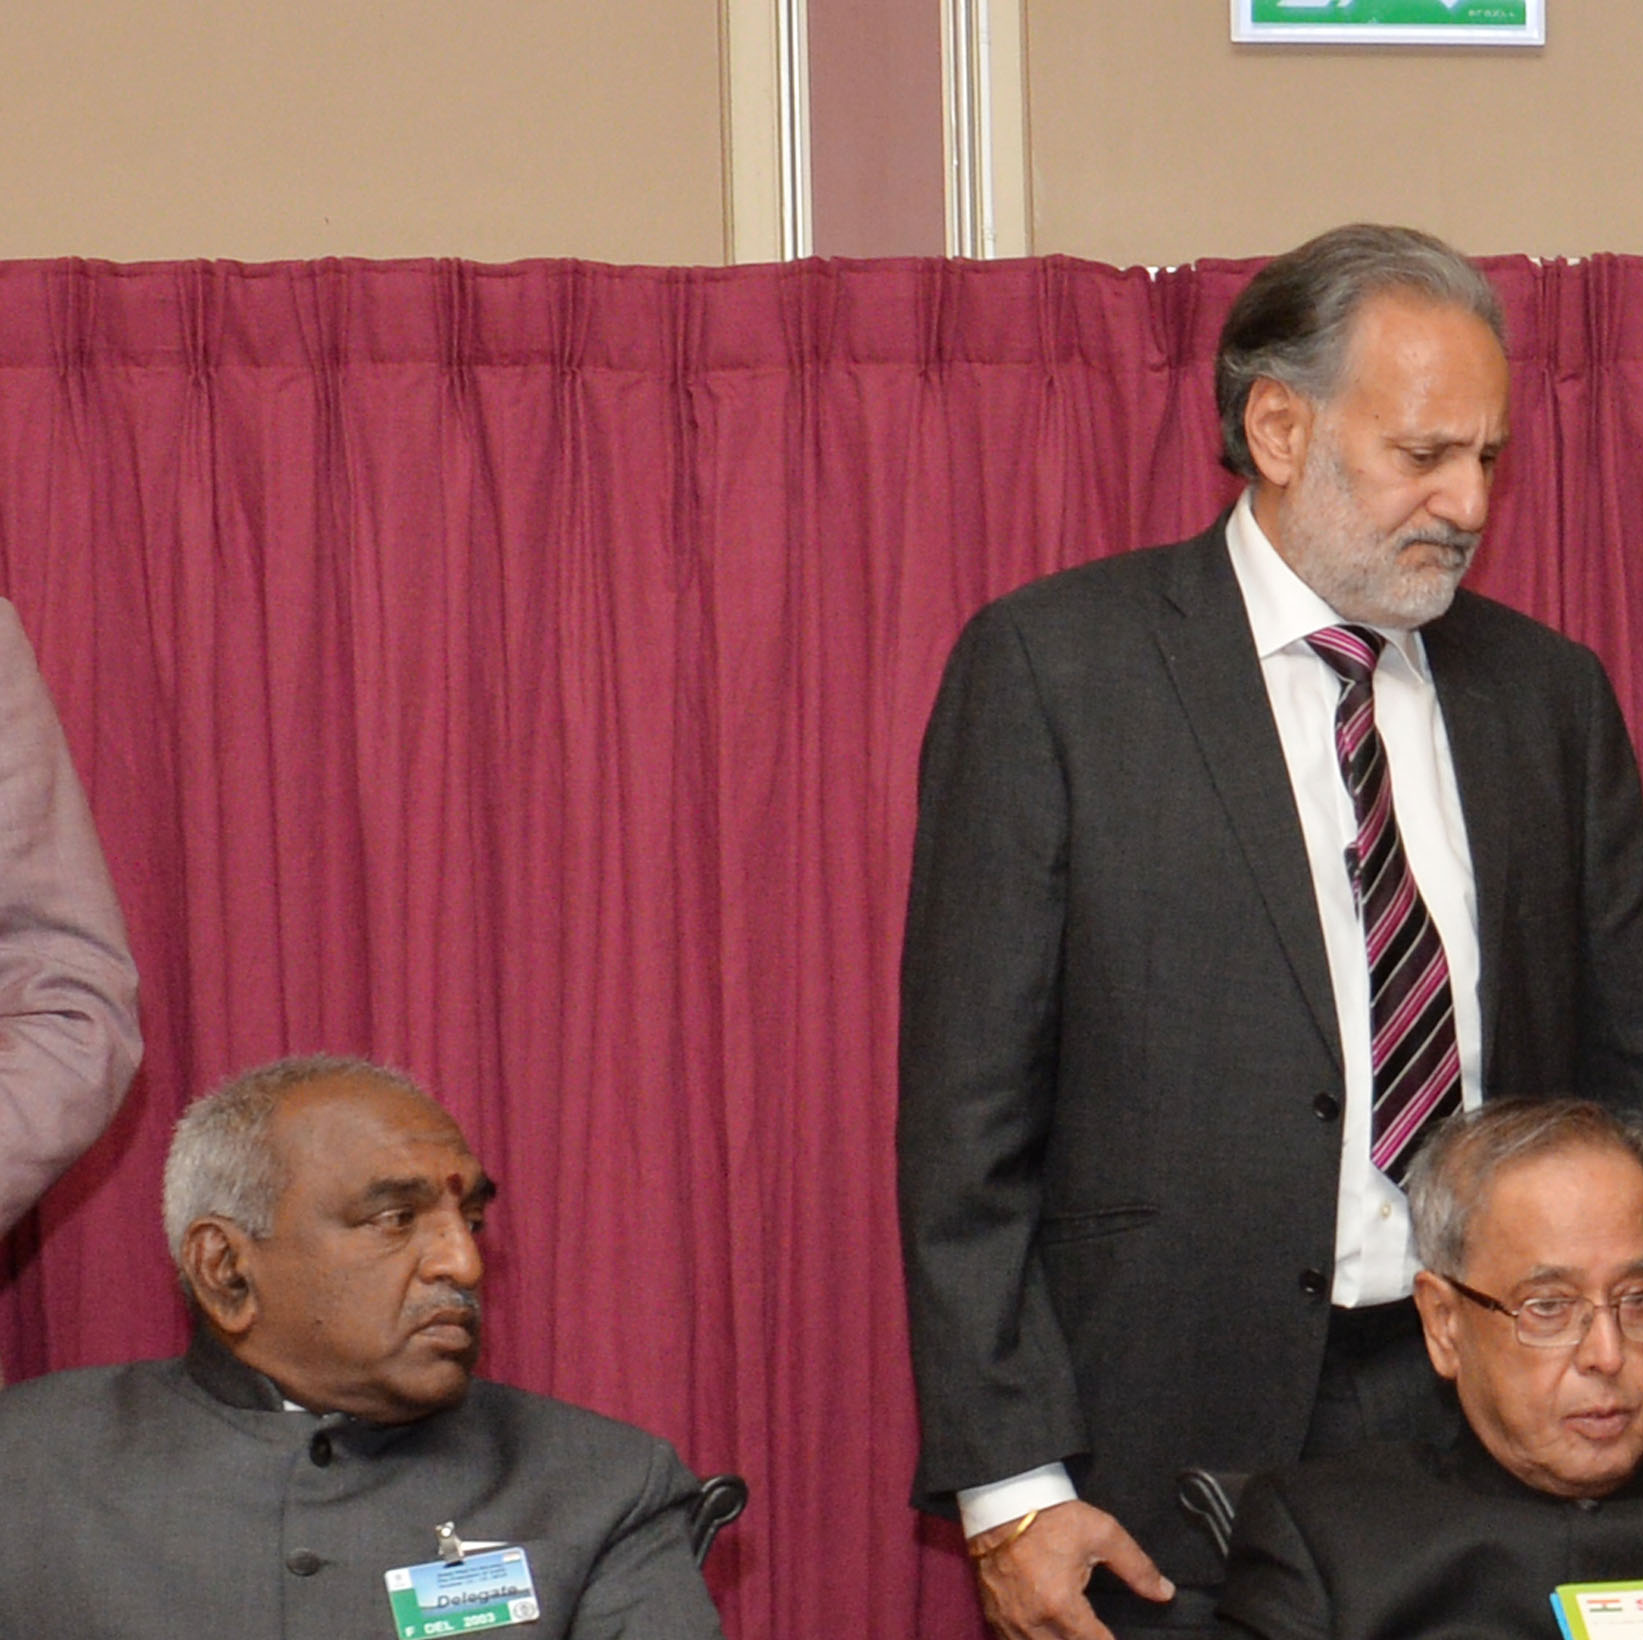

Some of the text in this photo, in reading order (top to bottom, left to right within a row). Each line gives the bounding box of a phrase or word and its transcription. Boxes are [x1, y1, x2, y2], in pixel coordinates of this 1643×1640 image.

[438, 1586, 517, 1608] Delegate
[404, 1626, 415, 1637] F
[424, 1621, 455, 1634] DEL
